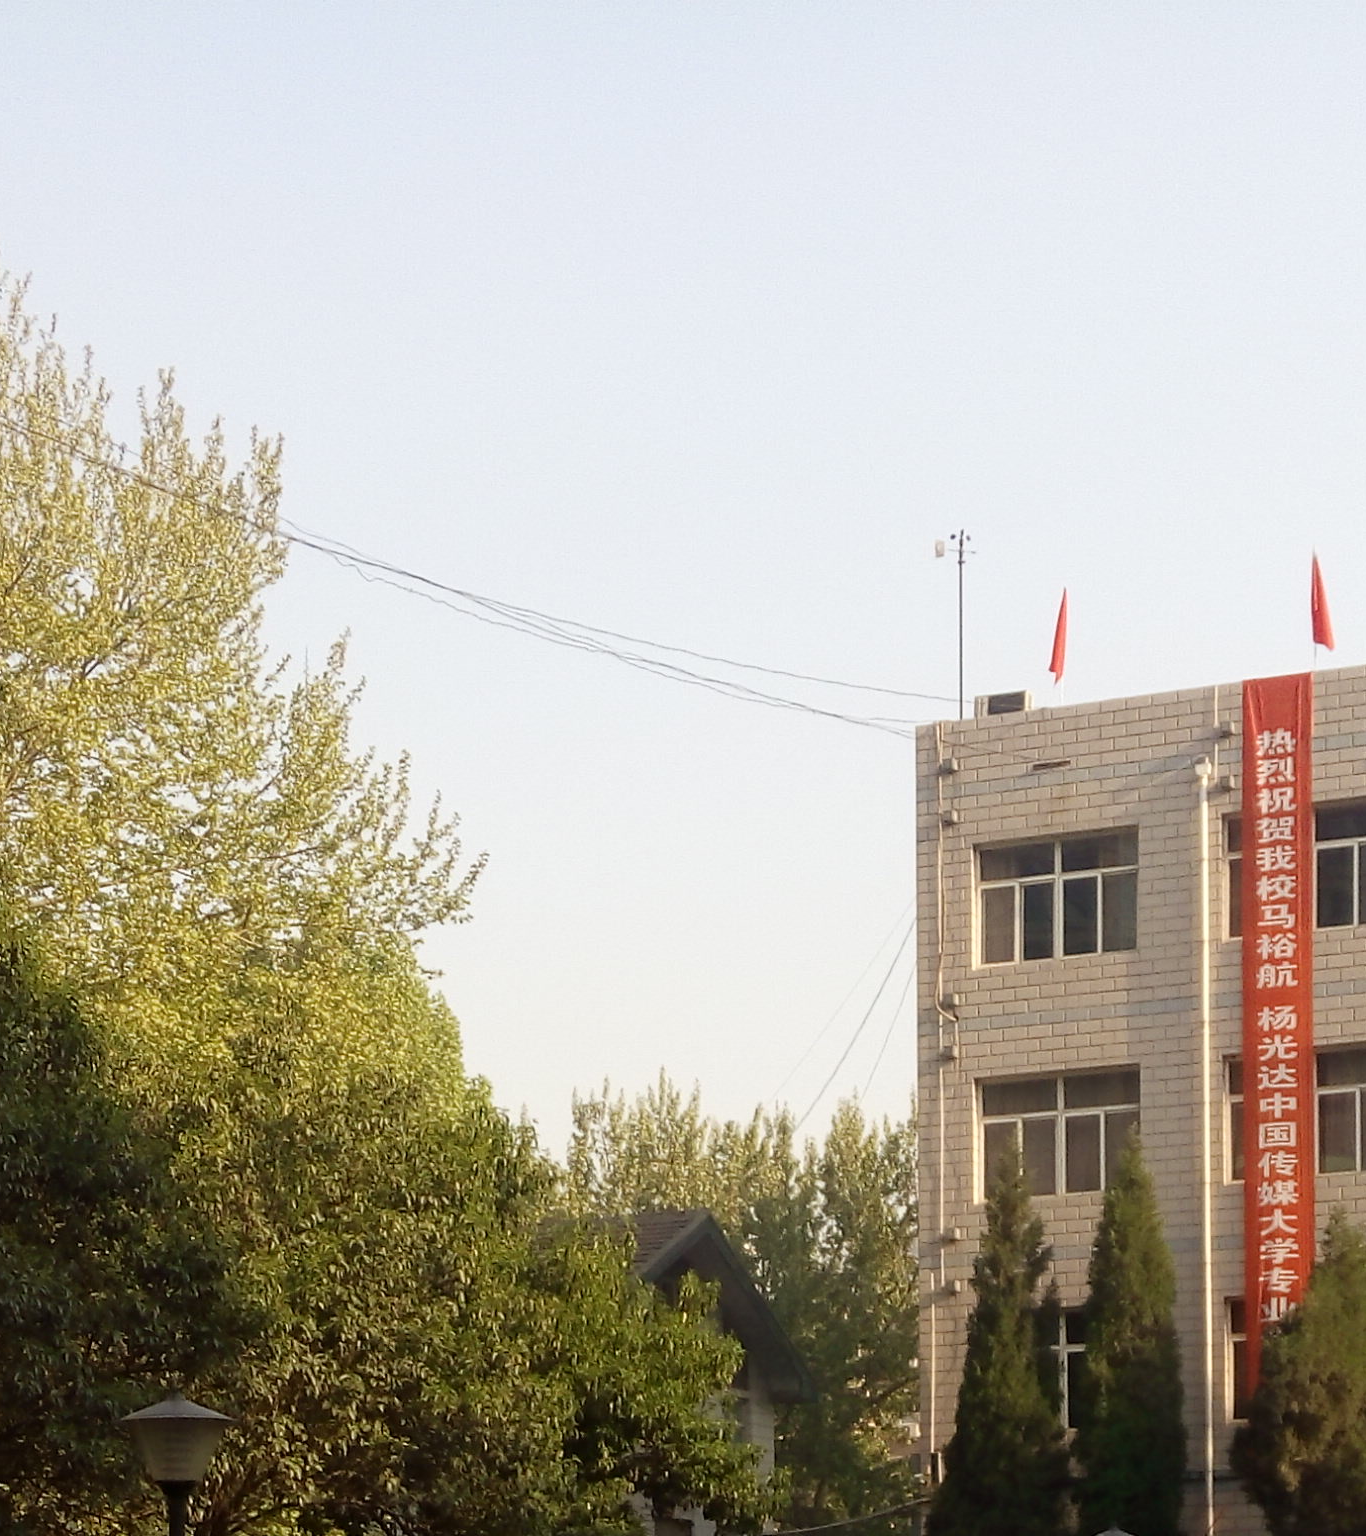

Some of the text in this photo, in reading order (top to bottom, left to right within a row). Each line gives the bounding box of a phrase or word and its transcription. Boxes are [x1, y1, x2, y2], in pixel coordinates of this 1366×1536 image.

[1255, 728, 1298, 989] 热烈祝贺我校马裕航
